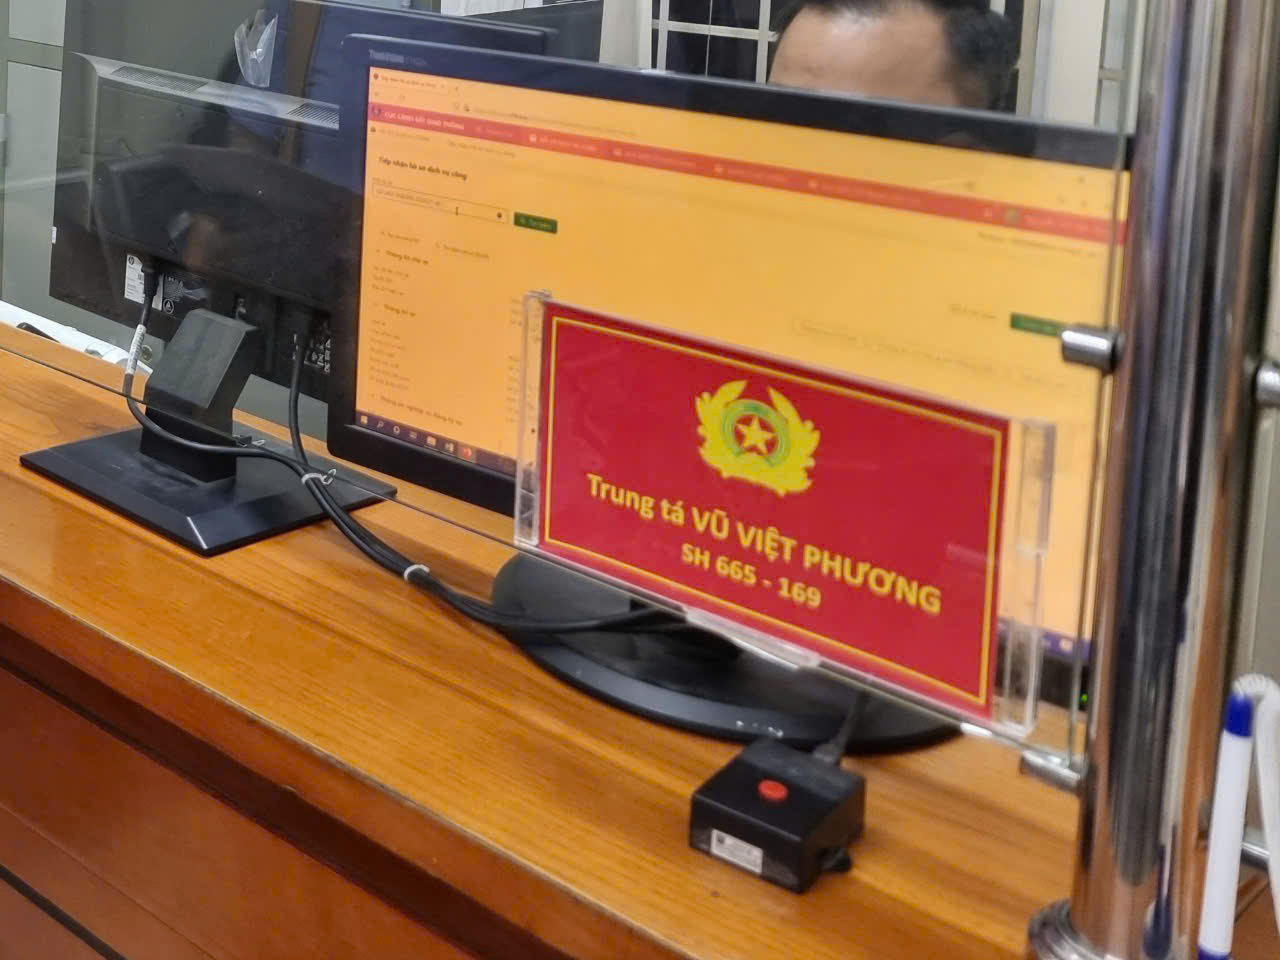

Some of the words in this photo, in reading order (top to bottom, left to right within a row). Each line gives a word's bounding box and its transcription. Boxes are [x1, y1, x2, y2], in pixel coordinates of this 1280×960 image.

[586, 472, 655, 520] Trung
[660, 498, 685, 526] tá
[691, 506, 730, 540] VŨ
[736, 521, 798, 563] VIỆT
[802, 543, 942, 615] PHƯƠNG
[681, 543, 711, 571] SH
[715, 555, 757, 587] 665
[778, 577, 822, 609] 169
